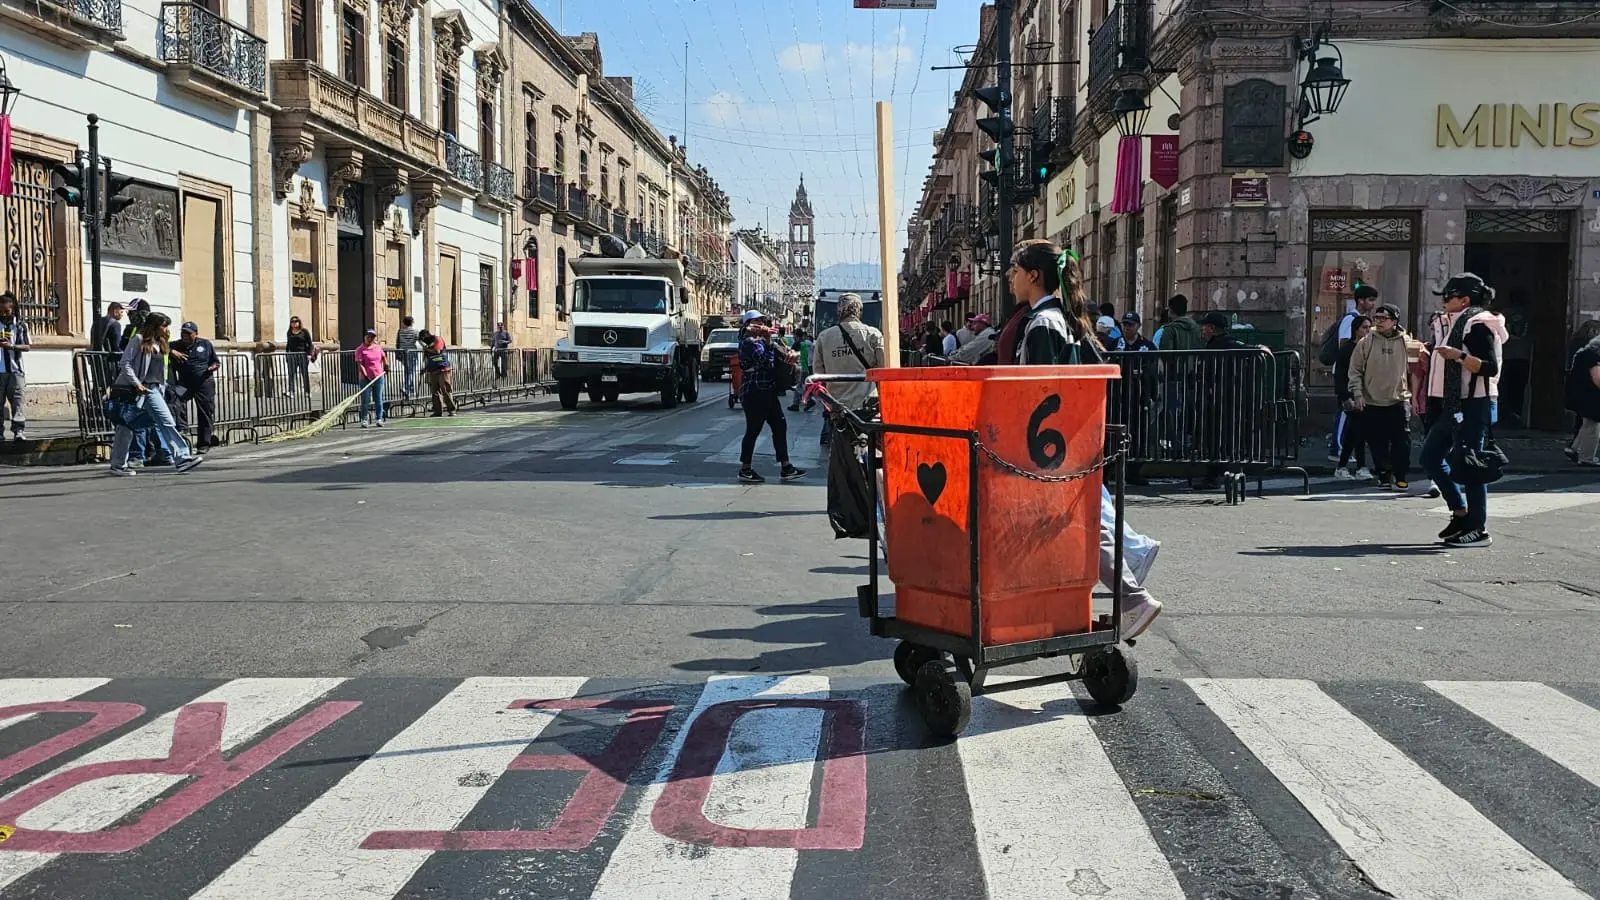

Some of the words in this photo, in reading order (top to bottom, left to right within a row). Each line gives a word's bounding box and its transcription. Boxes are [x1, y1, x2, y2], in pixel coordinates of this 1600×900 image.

[1436, 102, 1600, 147] MINIS
[292, 271, 317, 289] BBVA
[387, 286, 404, 300] BBVA
[1027, 393, 1066, 470] 6
